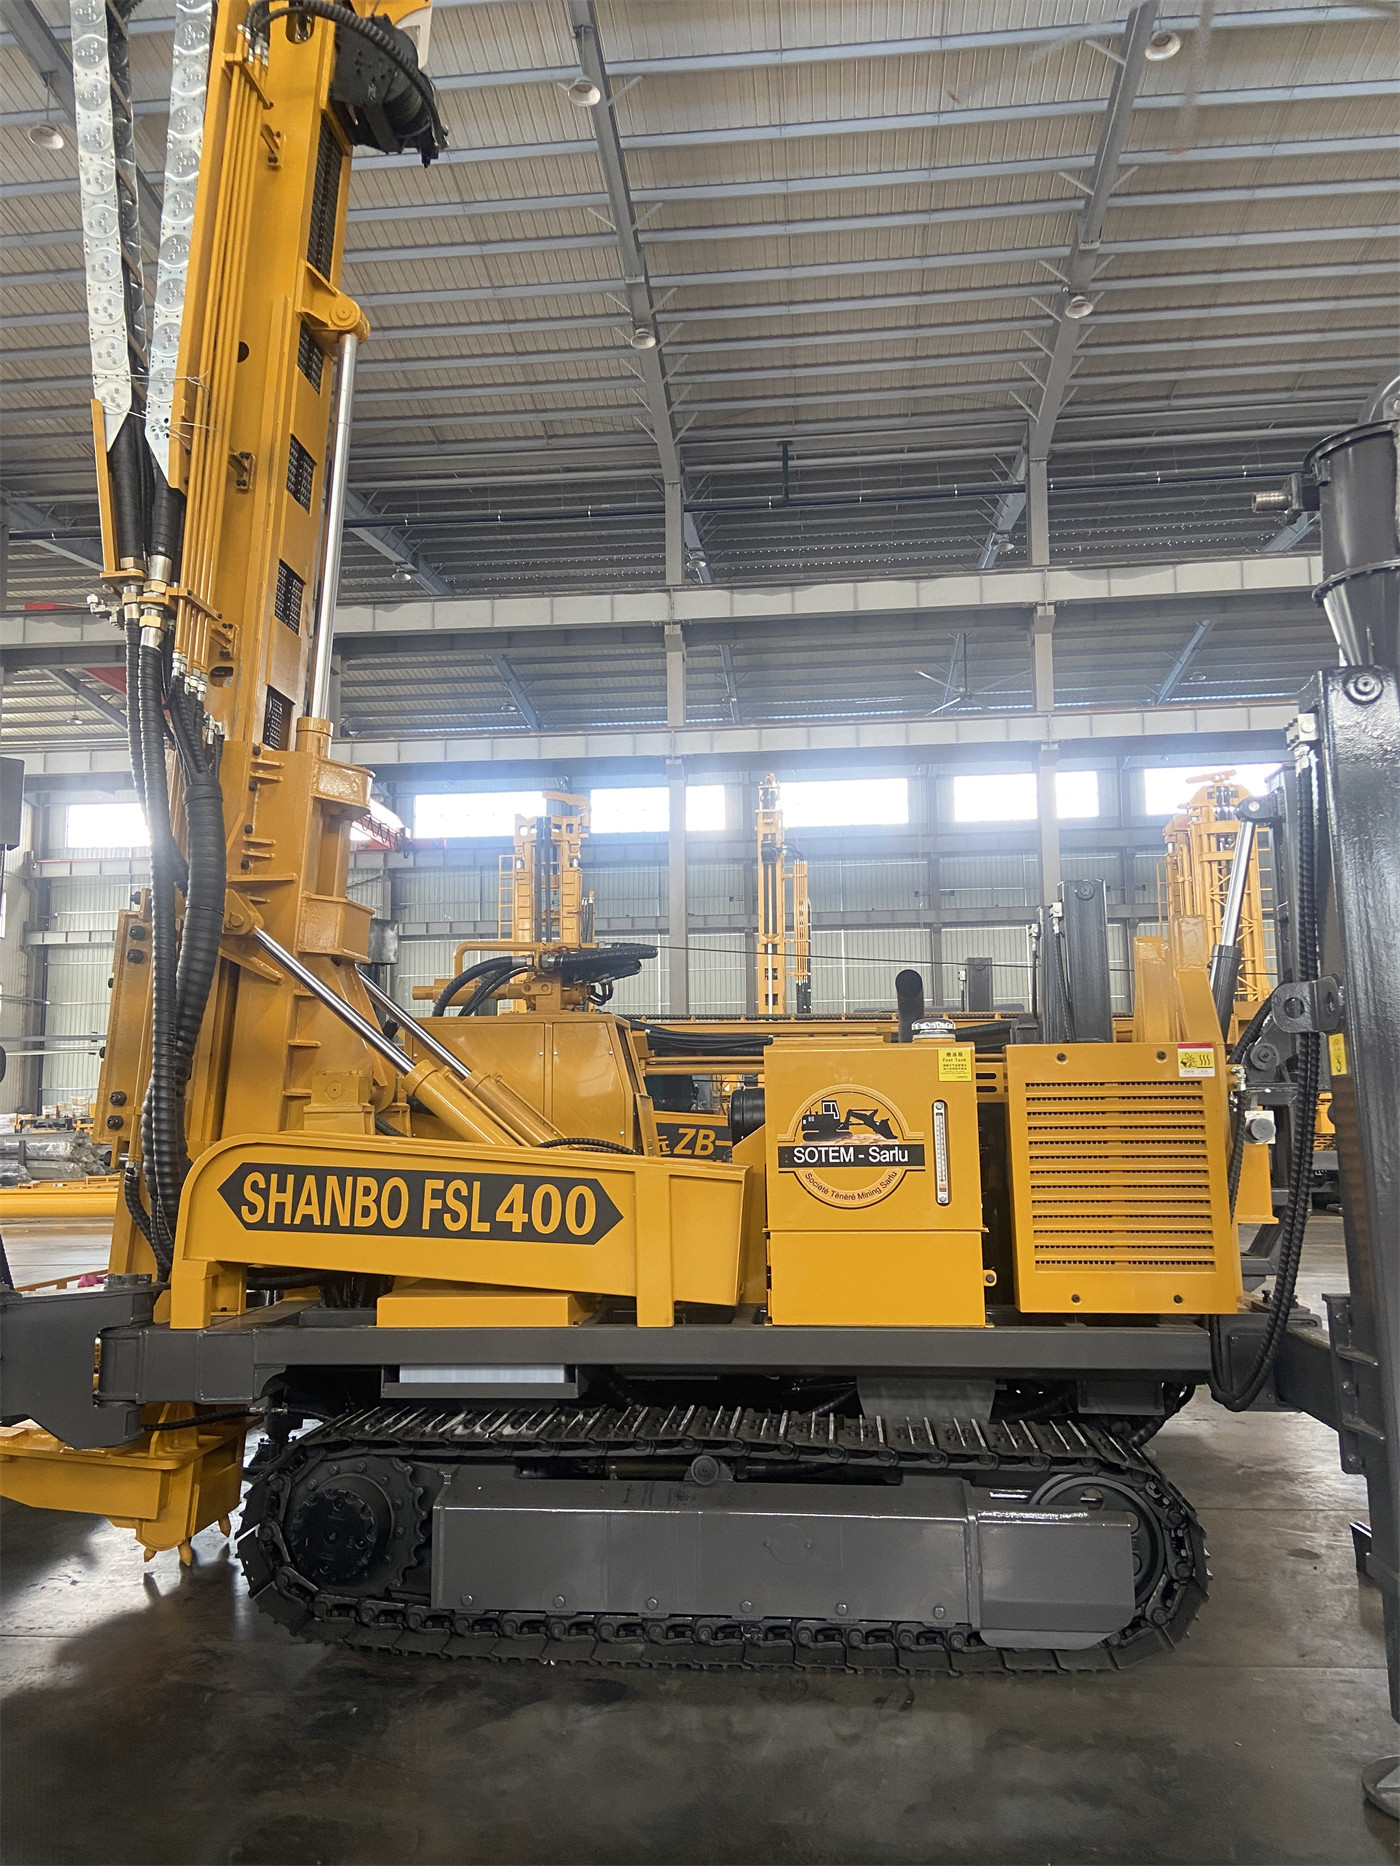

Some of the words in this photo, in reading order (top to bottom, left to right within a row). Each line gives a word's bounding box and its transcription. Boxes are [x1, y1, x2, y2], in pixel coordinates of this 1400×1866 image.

[793, 1146, 854, 1163] SOTEM
[868, 1146, 909, 1163] Sarlu
[240, 1171, 410, 1229] SHANBO
[857, 1187, 882, 1200] Mining
[880, 1171, 898, 1188] Sarlu
